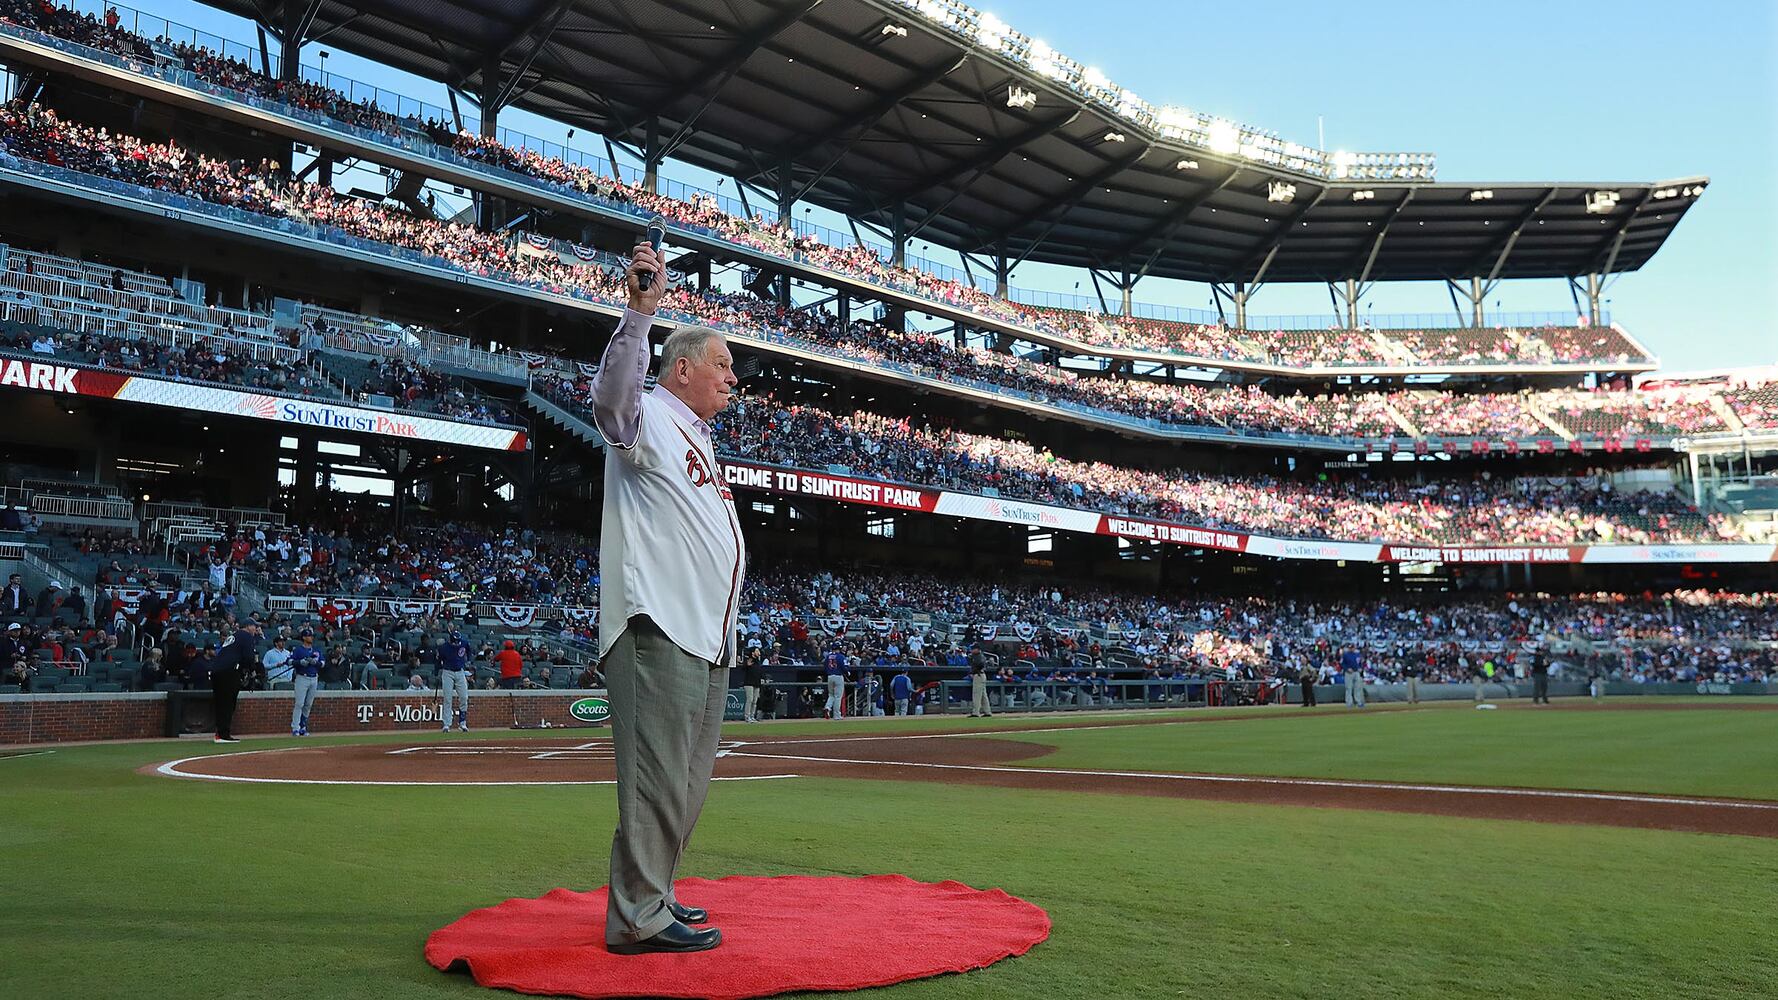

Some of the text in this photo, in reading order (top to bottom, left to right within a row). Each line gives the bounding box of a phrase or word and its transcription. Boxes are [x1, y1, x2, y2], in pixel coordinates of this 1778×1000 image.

[0, 358, 79, 394] ARK
[724, 464, 773, 489] COME
[775, 471, 798, 492] TO
[801, 475, 881, 503] SUNTRUST
[884, 487, 922, 508] PARK
[1108, 518, 1240, 549] WELCOME TO SUNTRUST PARK
[1389, 546, 1570, 562] WELCOME TO SUNTRUST PARK
[576, 703, 609, 715] Scotts
[727, 700, 745, 711] kday
